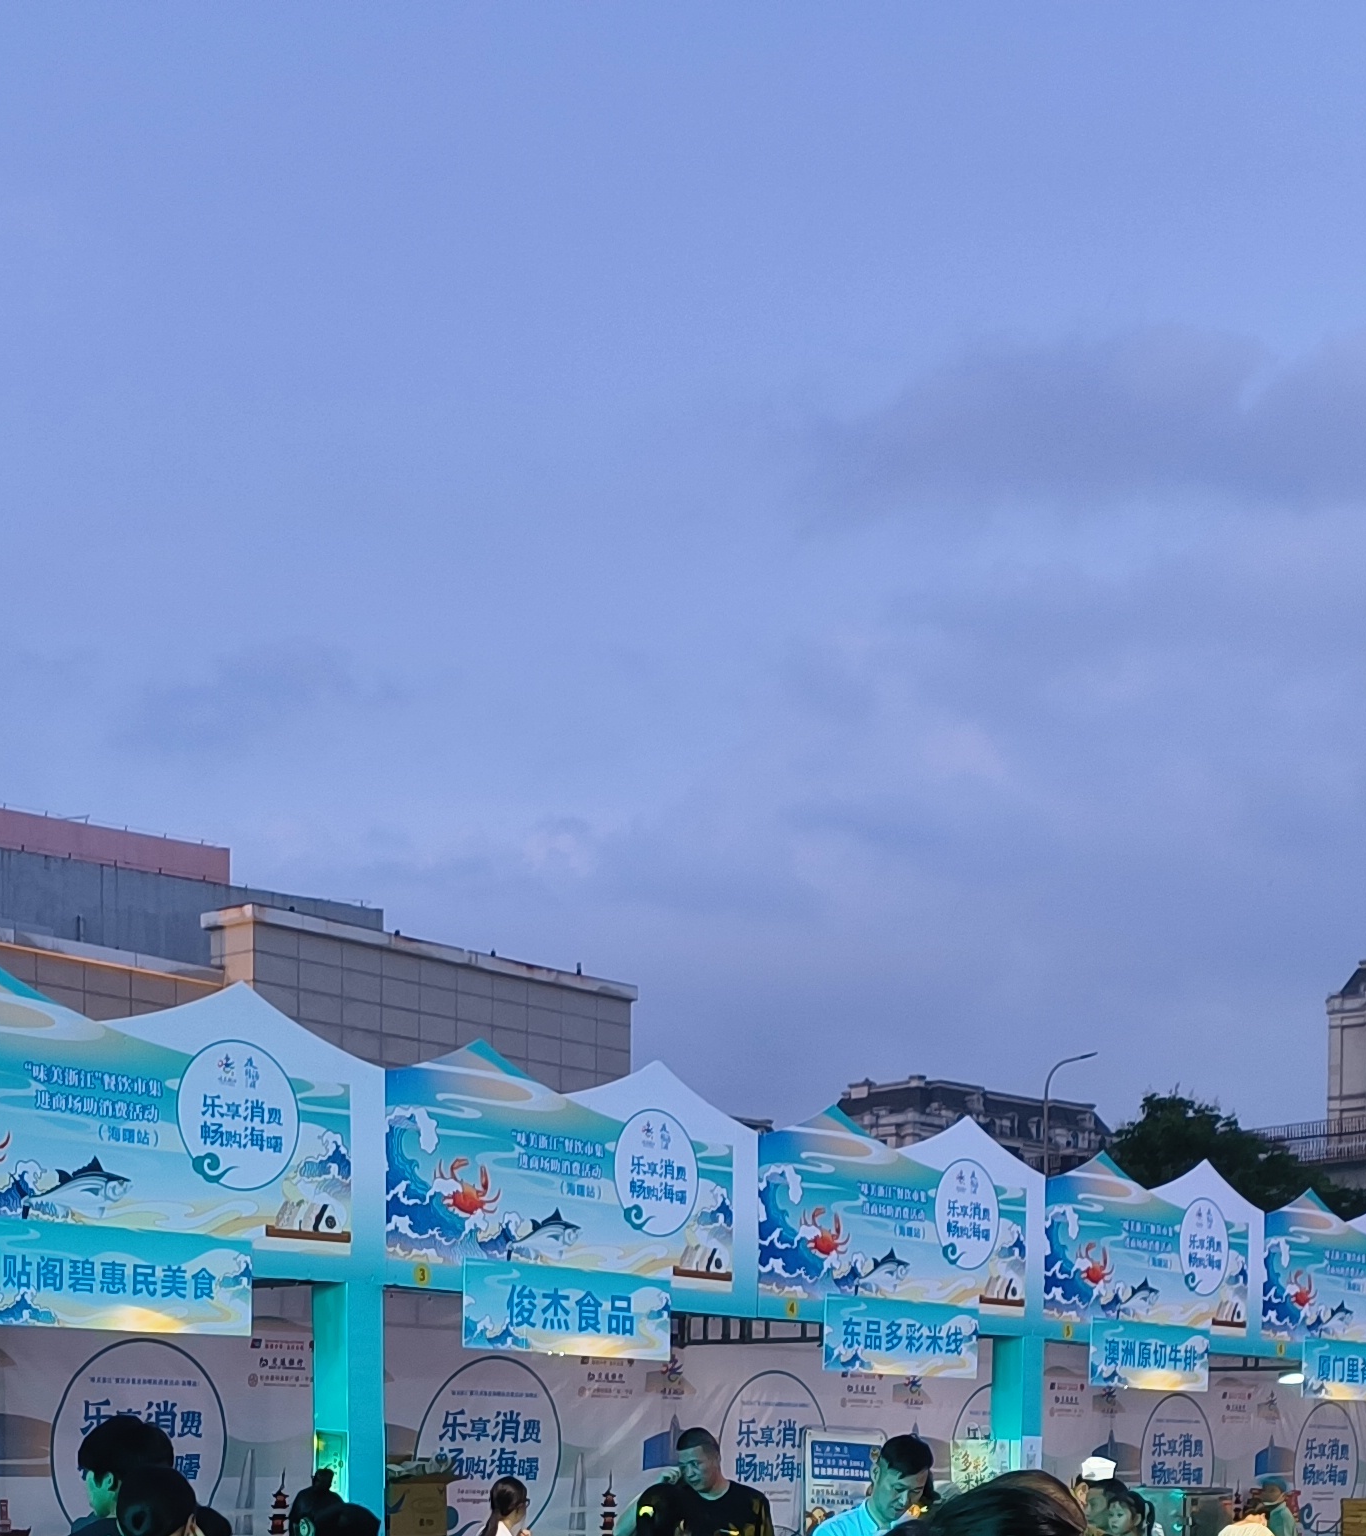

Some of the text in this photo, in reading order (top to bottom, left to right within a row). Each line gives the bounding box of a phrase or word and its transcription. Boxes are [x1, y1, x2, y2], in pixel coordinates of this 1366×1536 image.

[35, 1089, 160, 1124] 进商场助消费活动
[201, 1093, 283, 1126] 乐享消费
[200, 1121, 283, 1154] 畅购海曙
[630, 1154, 687, 1182] 乐享消费
[2, 1253, 216, 1301] 贴阁碧惠民美食
[419, 1267, 426, 1282] 3
[507, 1284, 635, 1337] 俊杰食品
[1104, 1338, 1197, 1372] 澳洲原切牛排
[439, 1408, 541, 1443] 乐享消费
[736, 1418, 803, 1448] 乐享消
[735, 1453, 802, 1483] 畅购海
